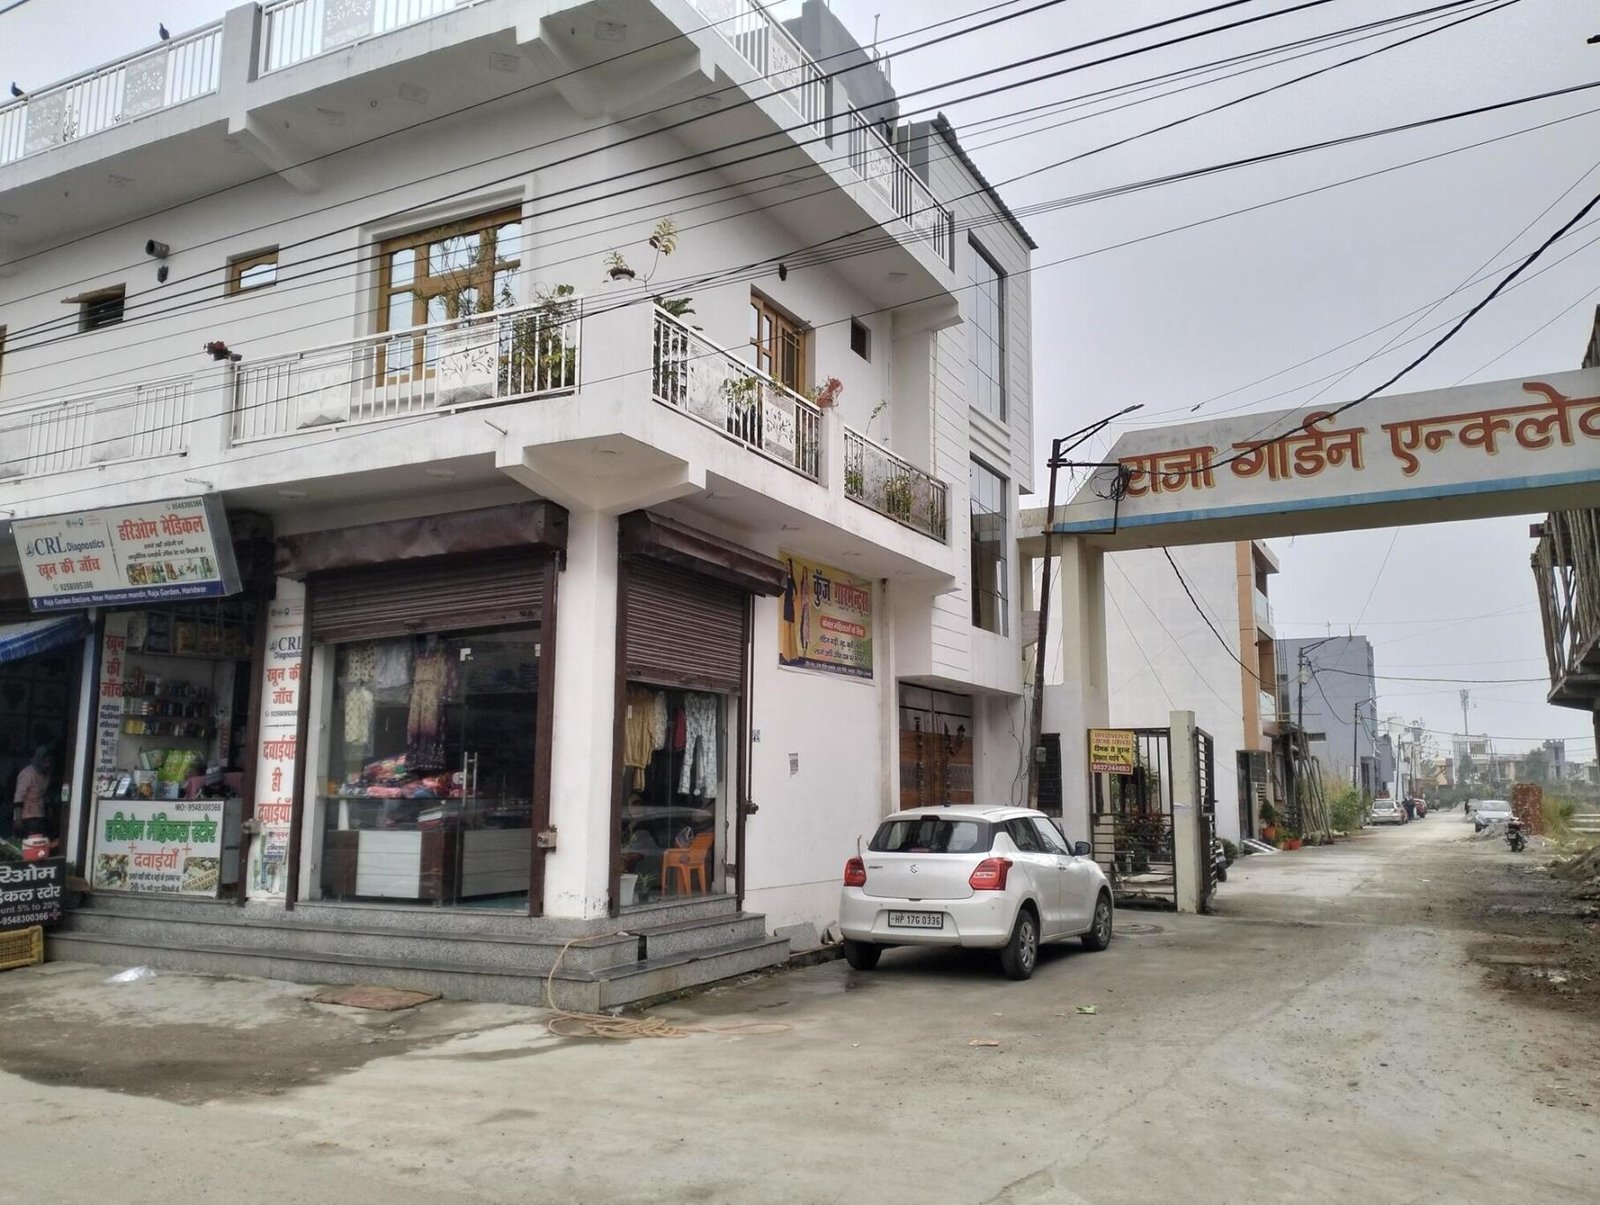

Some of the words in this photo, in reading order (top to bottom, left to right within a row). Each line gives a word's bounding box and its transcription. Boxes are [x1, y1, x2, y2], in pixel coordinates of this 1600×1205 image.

[1118, 445, 1218, 497] राजा
[1231, 411, 1368, 481] गार्डन
[117, 517, 159, 541] हरिओम
[160, 513, 205, 536] मेडिकल
[34, 536, 67, 556] CRL
[66, 540, 106, 553] Diagnostics
[36, 563, 57, 580] खून
[59, 557, 75, 574] की
[266, 667, 286, 687] खून
[36, 883, 62, 900] स्टोर
[31, 903, 41, 911] to
[894, 914, 904, 924] HP
